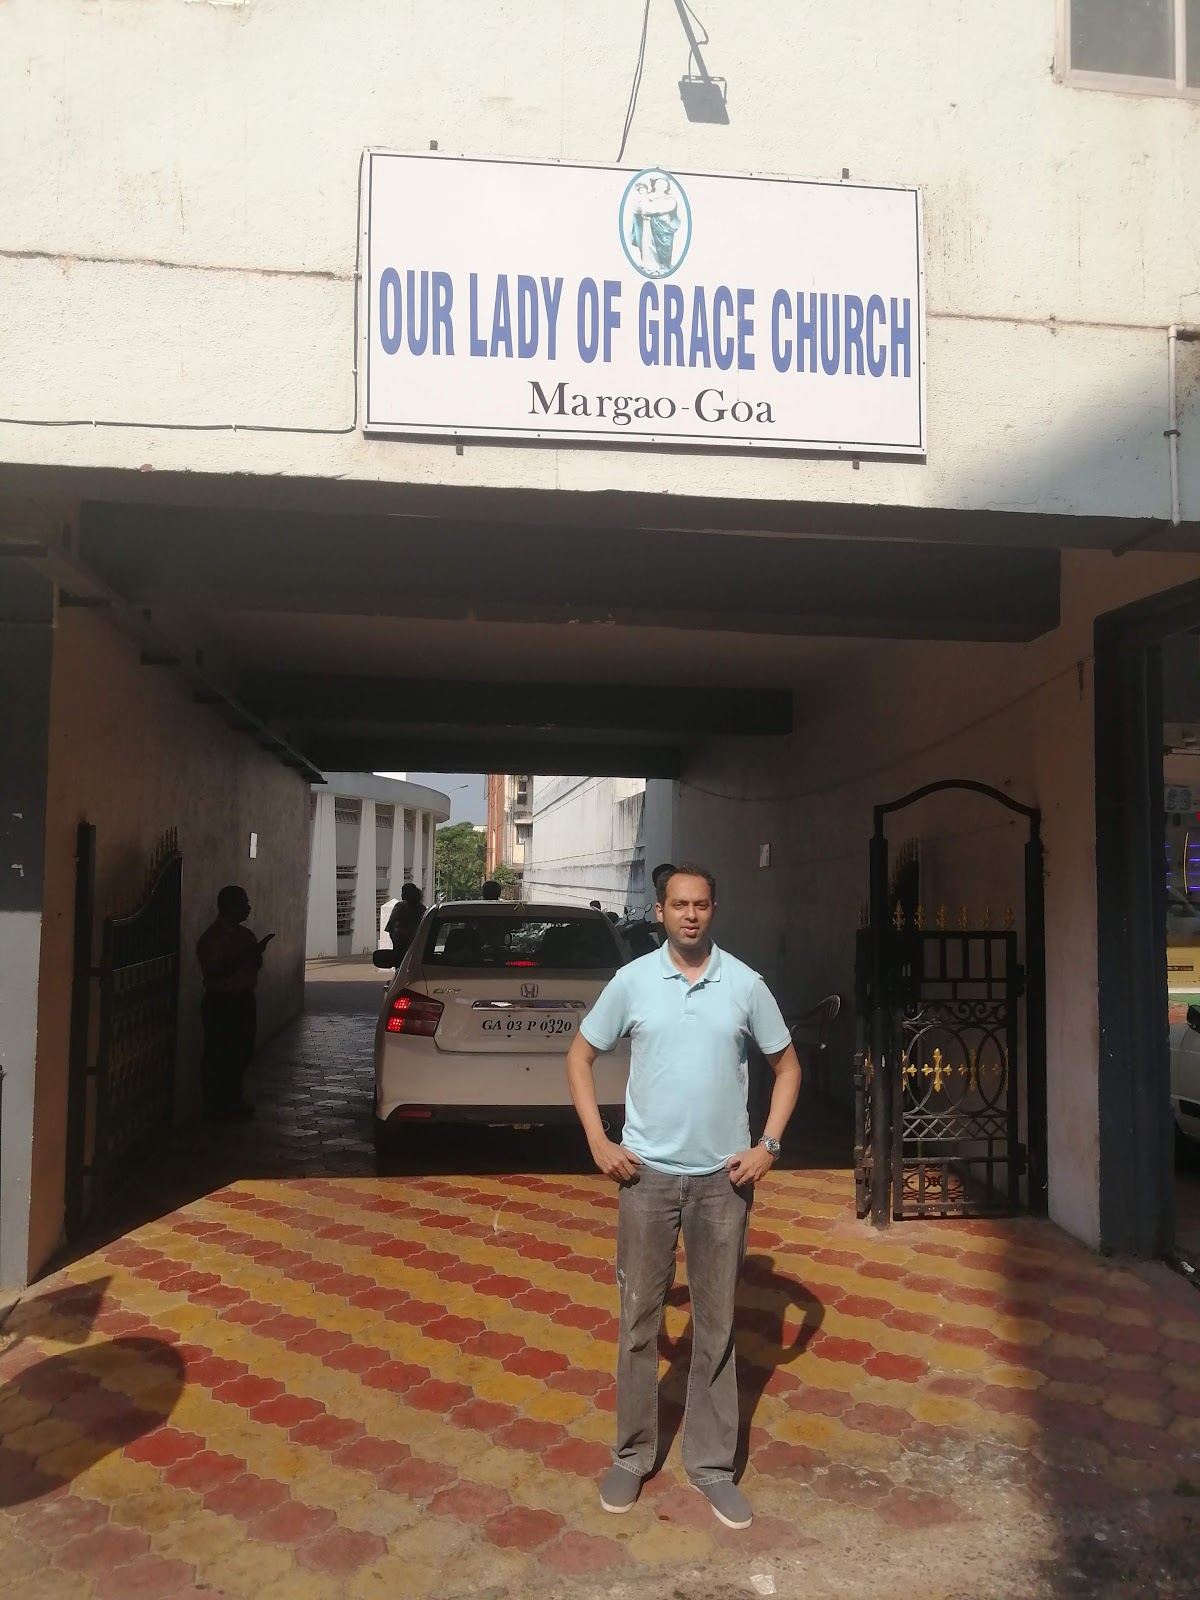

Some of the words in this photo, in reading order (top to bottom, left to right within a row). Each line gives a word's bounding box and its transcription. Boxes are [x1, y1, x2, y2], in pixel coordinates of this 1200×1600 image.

[379, 267, 455, 356] OUR
[469, 272, 564, 360] LADY
[577, 277, 622, 363] OF
[638, 281, 755, 370] GRACE
[771, 288, 911, 377] CHURCH
[482, 1019, 502, 1031] GA
[506, 1020, 522, 1031] 03
[527, 1020, 537, 1031] P
[540, 1019, 572, 1034] 0320
